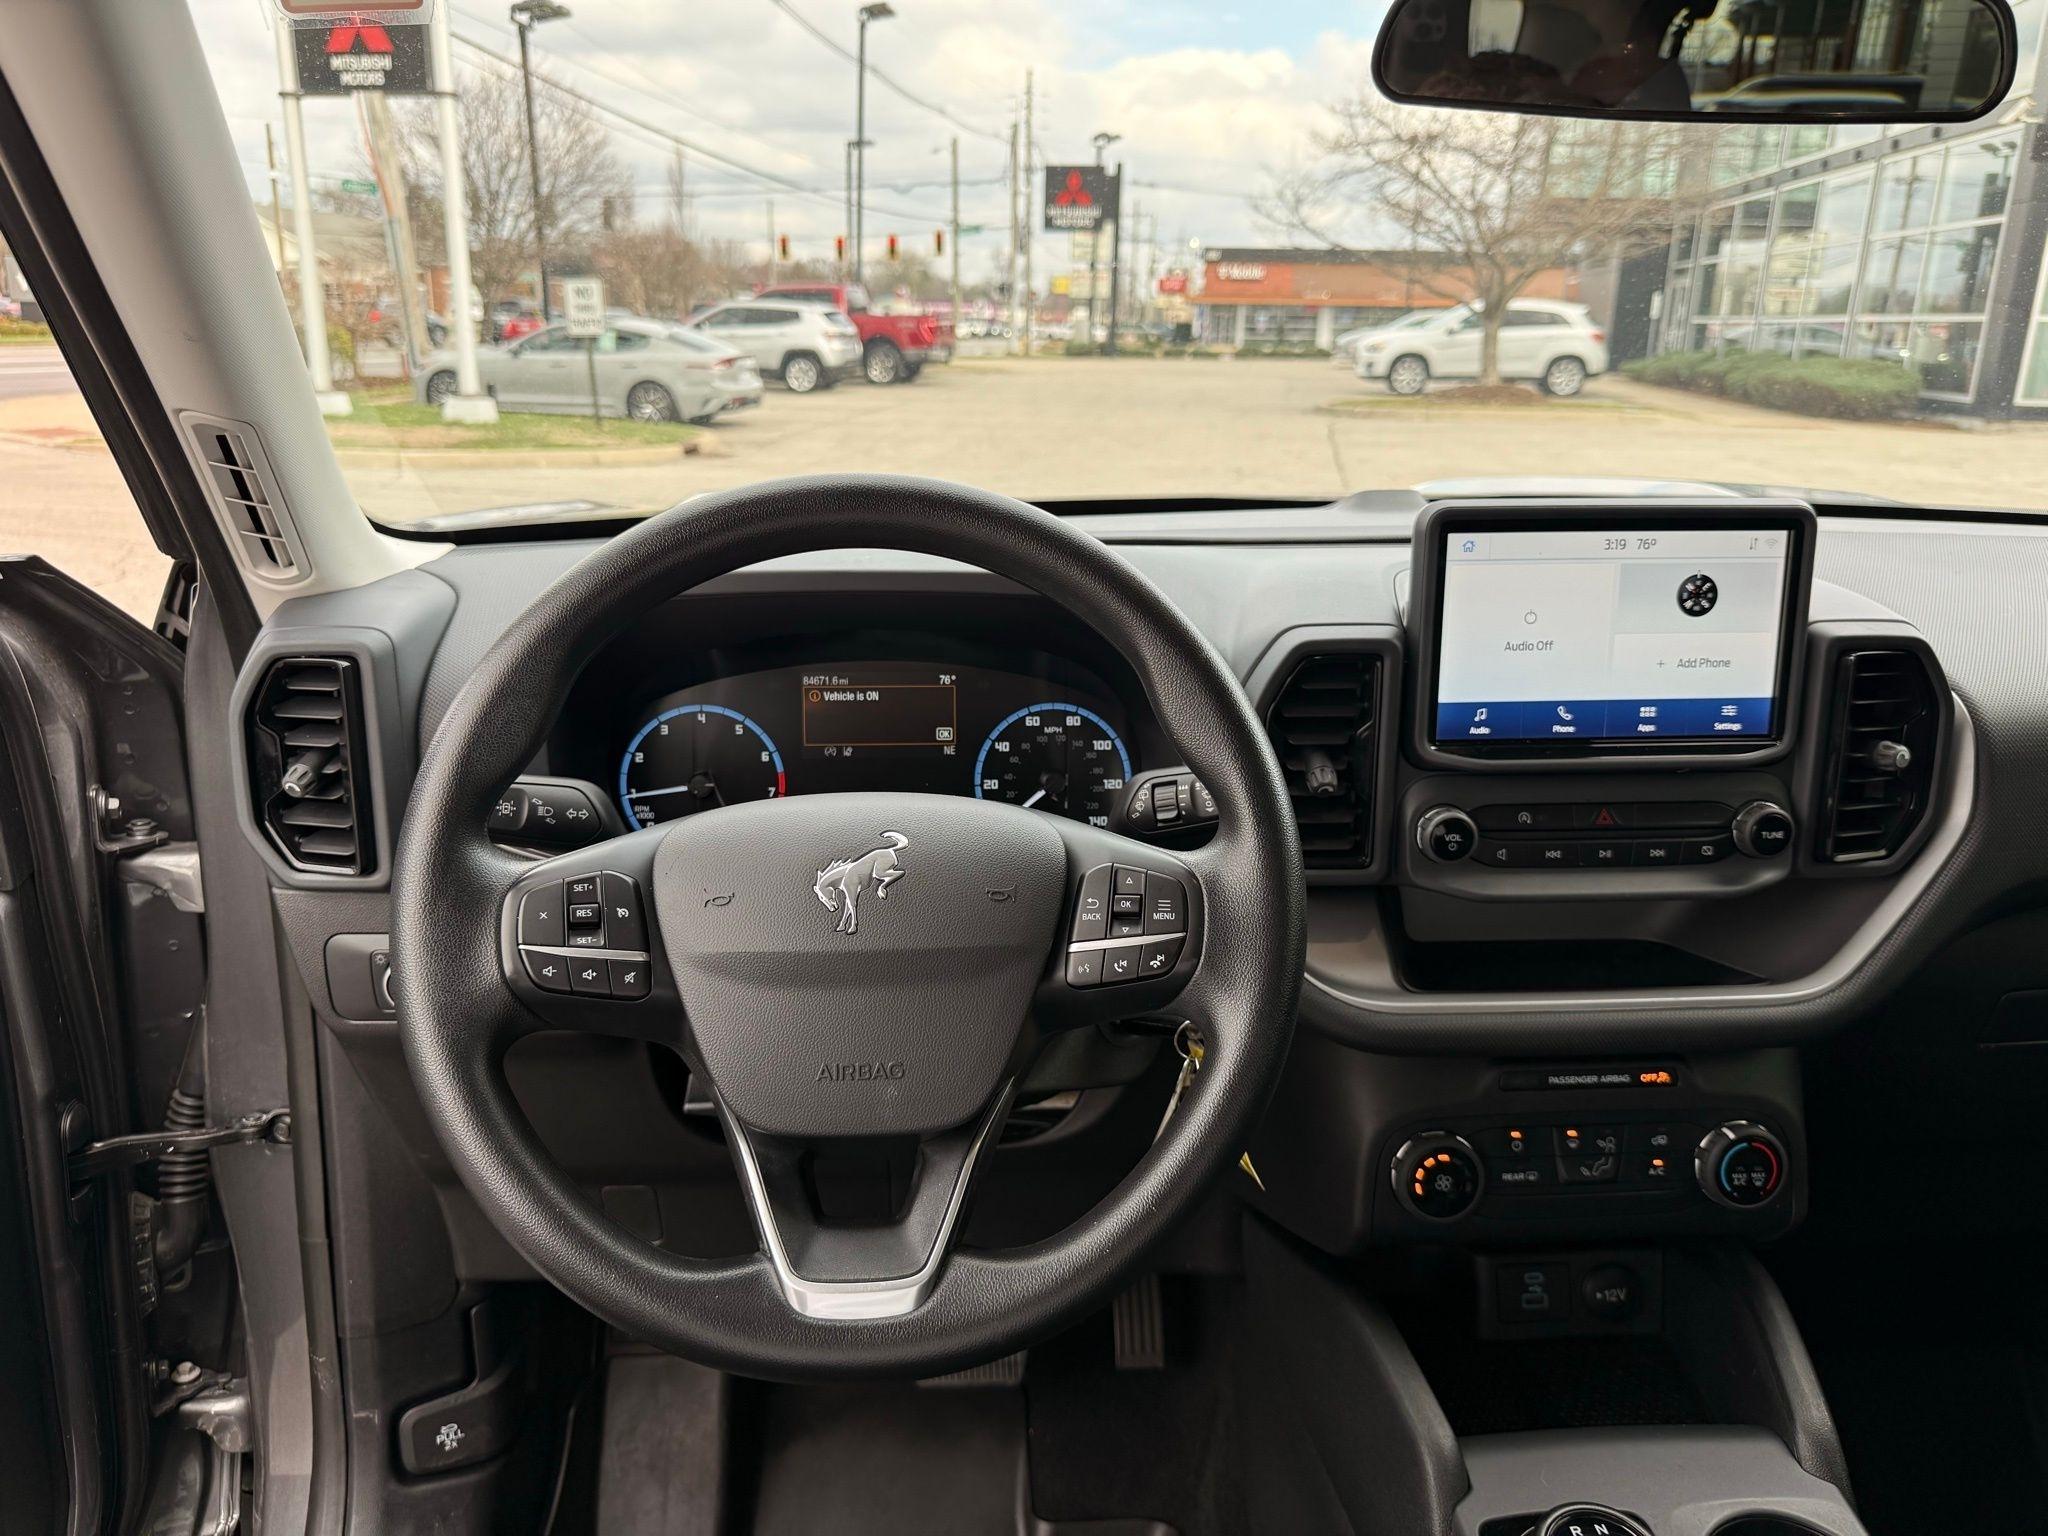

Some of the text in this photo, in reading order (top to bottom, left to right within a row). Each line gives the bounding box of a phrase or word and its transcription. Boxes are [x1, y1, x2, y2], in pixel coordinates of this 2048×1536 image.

[1604, 538, 1627, 550] 3:19
[1504, 640, 1554, 651] Audio Off
[1677, 657, 1731, 668] Add Phone
[803, 676, 849, 685] 84671.6 mi
[823, 690, 879, 701] Vehicle is ON
[697, 713, 706, 724] 4
[1025, 716, 1040, 726] 60
[1066, 716, 1081, 726] 80
[660, 724, 669, 735] 3
[735, 724, 744, 735] 5
[1044, 726, 1063, 734] MPH
[1469, 726, 1492, 735] Audio
[1552, 724, 1577, 733] Phone
[1637, 724, 1657, 733] Apps
[1713, 721, 1743, 731] Settings
[938, 729, 951, 739] OK
[944, 746, 956, 755] NE
[994, 741, 1010, 752] 40
[1092, 740, 1112, 750] 100
[634, 752, 644, 763] 2
[761, 751, 770, 762] 6
[983, 779, 999, 790] 20
[1103, 779, 1123, 790] 120
[768, 787, 776, 798] 7
[1088, 816, 1108, 827] 140
[1761, 831, 1784, 839] TUNE
[576, 909, 593, 917] RES
[1082, 913, 1101, 921] BACK
[1153, 912, 1175, 920] MENU
[816, 1062, 904, 1081] AIRBAG
[1548, 1075, 1599, 1084] PASSENGER
[1600, 1074, 1631, 1083] AIRBAG
[1649, 1168, 1664, 1176] A/C
[436, 1427, 466, 1446] PULL
[1569, 1525, 1584, 1536] R
[1594, 1523, 1609, 1536] N
